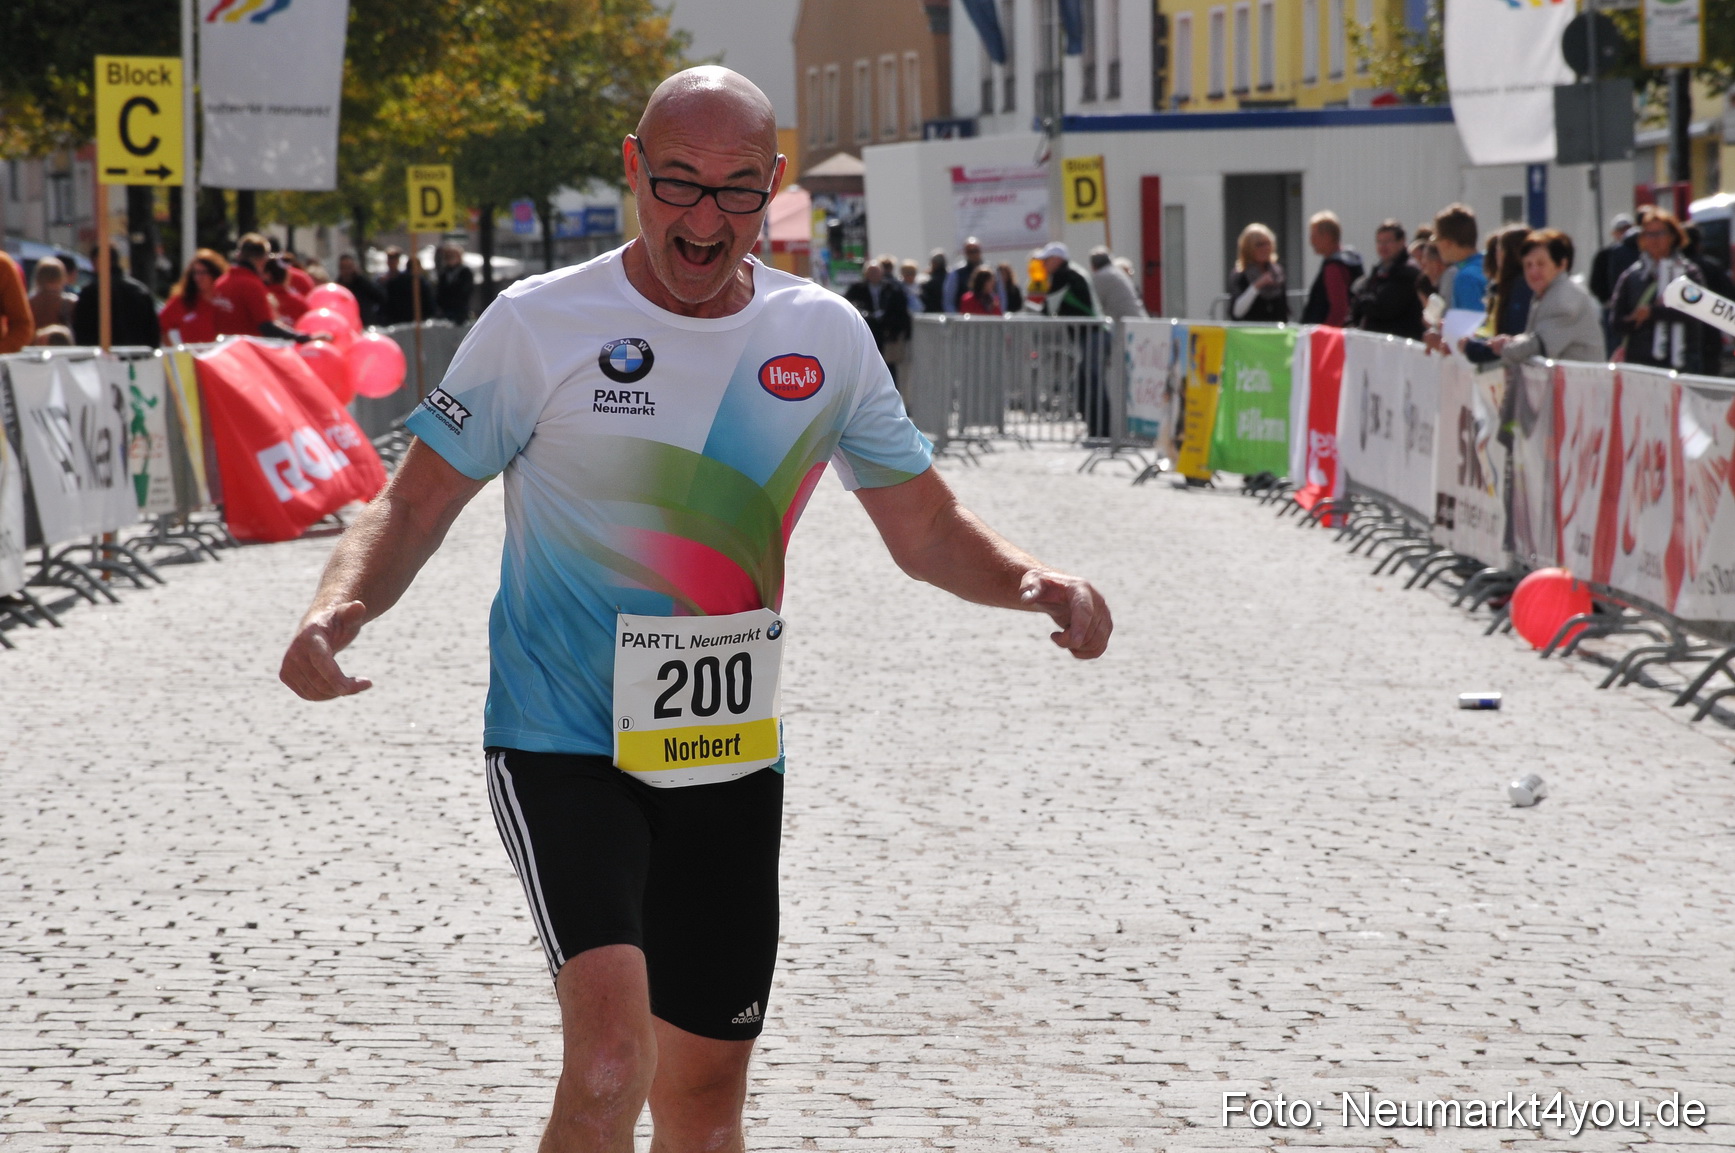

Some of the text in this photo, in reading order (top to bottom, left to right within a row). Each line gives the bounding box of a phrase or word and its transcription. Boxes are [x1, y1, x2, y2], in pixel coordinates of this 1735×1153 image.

[107, 62, 172, 86] Block
[118, 95, 161, 157] C
[420, 186, 443, 217] D
[1074, 175, 1098, 208] D
[603, 338, 650, 353] BMW
[768, 366, 818, 388] Hervis
[592, 402, 656, 416] Neumarkt
[593, 389, 656, 406] PARTL
[435, 413, 461, 436] concepts
[621, 632, 686, 650] PARTL
[689, 627, 762, 649] Neumarkt
[653, 651, 753, 720] 200
[622, 717, 631, 730] D
[664, 733, 741, 763] Norbert
[731, 1015, 761, 1024] adidas
